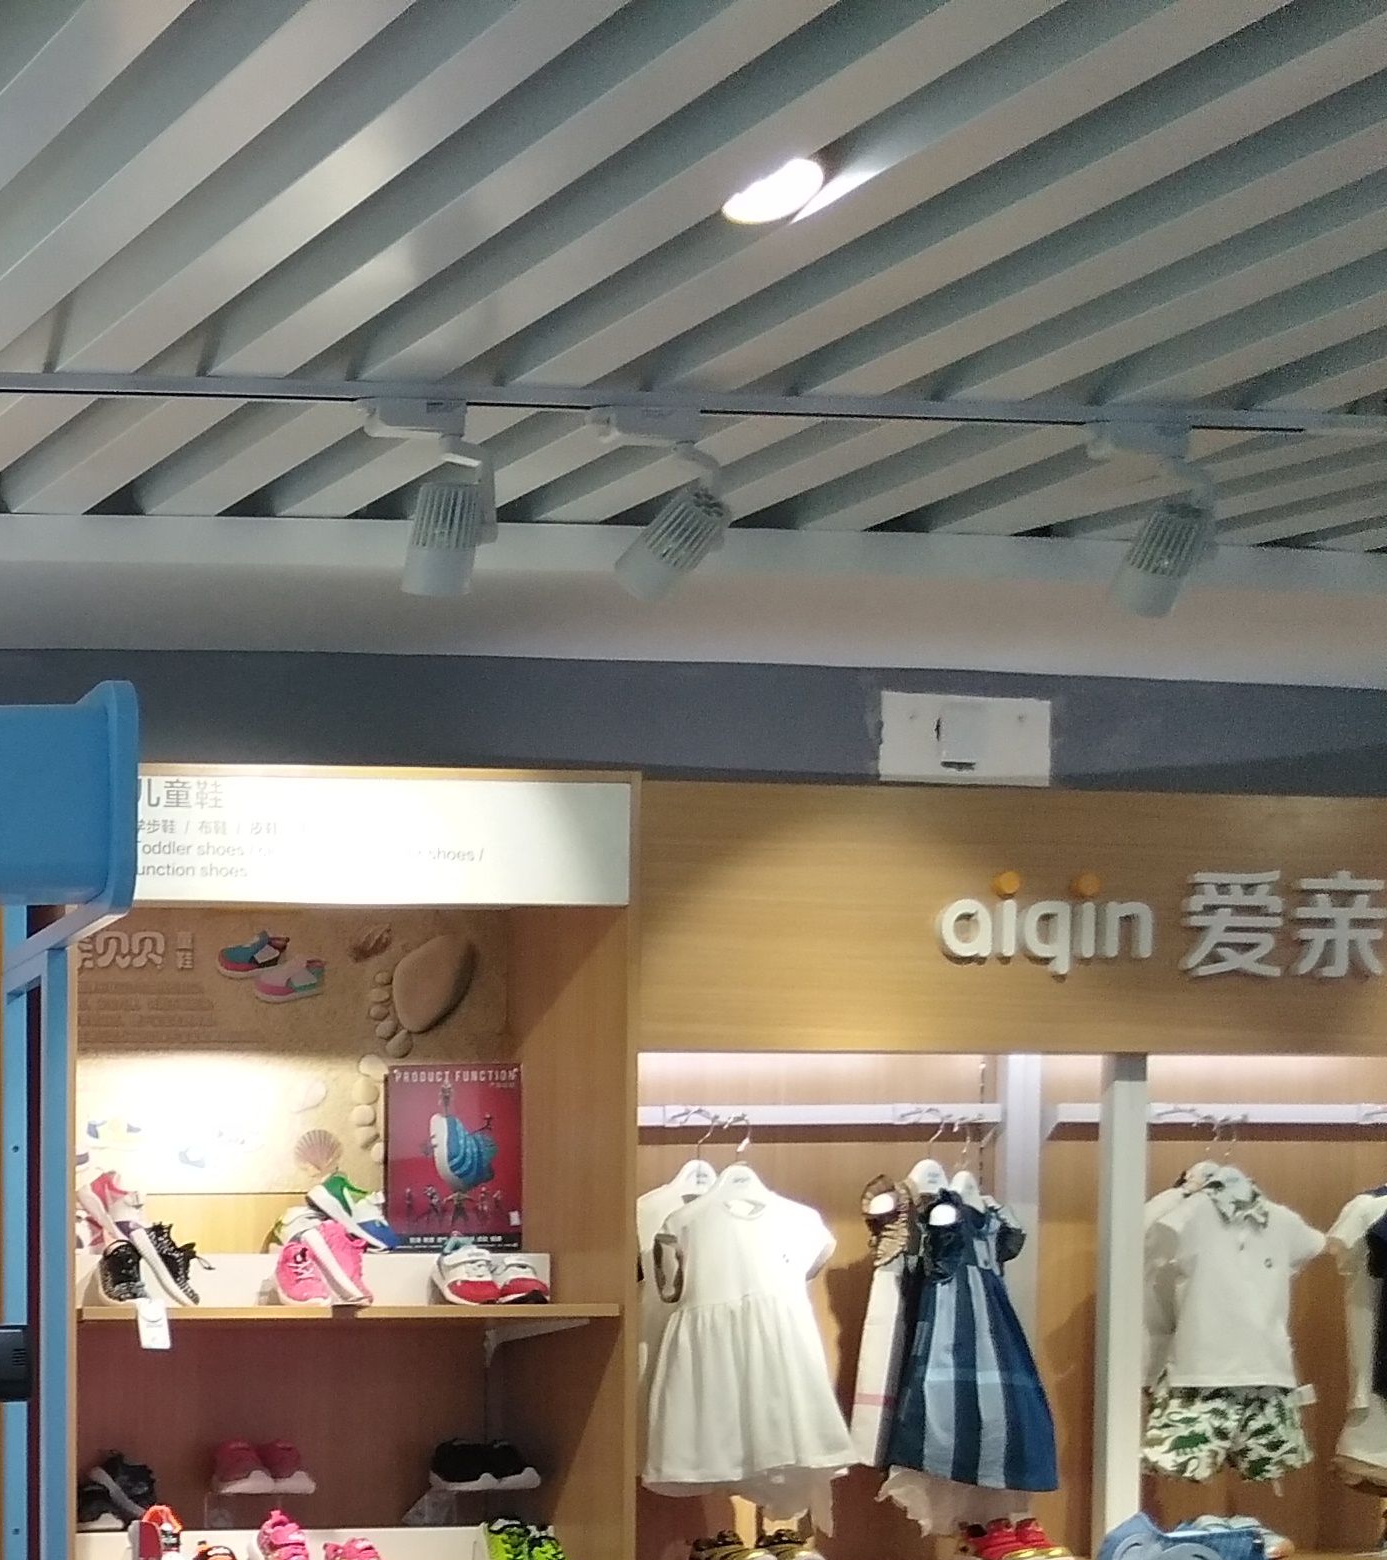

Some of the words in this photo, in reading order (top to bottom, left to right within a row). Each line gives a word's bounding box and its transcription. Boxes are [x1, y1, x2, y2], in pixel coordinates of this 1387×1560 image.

[138, 862, 195, 877] unction
[941, 871, 1153, 975] aiqin
[1180, 871, 1385, 977] 爱亲
[395, 1070, 449, 1082] PRODUCT
[455, 1069, 517, 1082] FUNCTION
